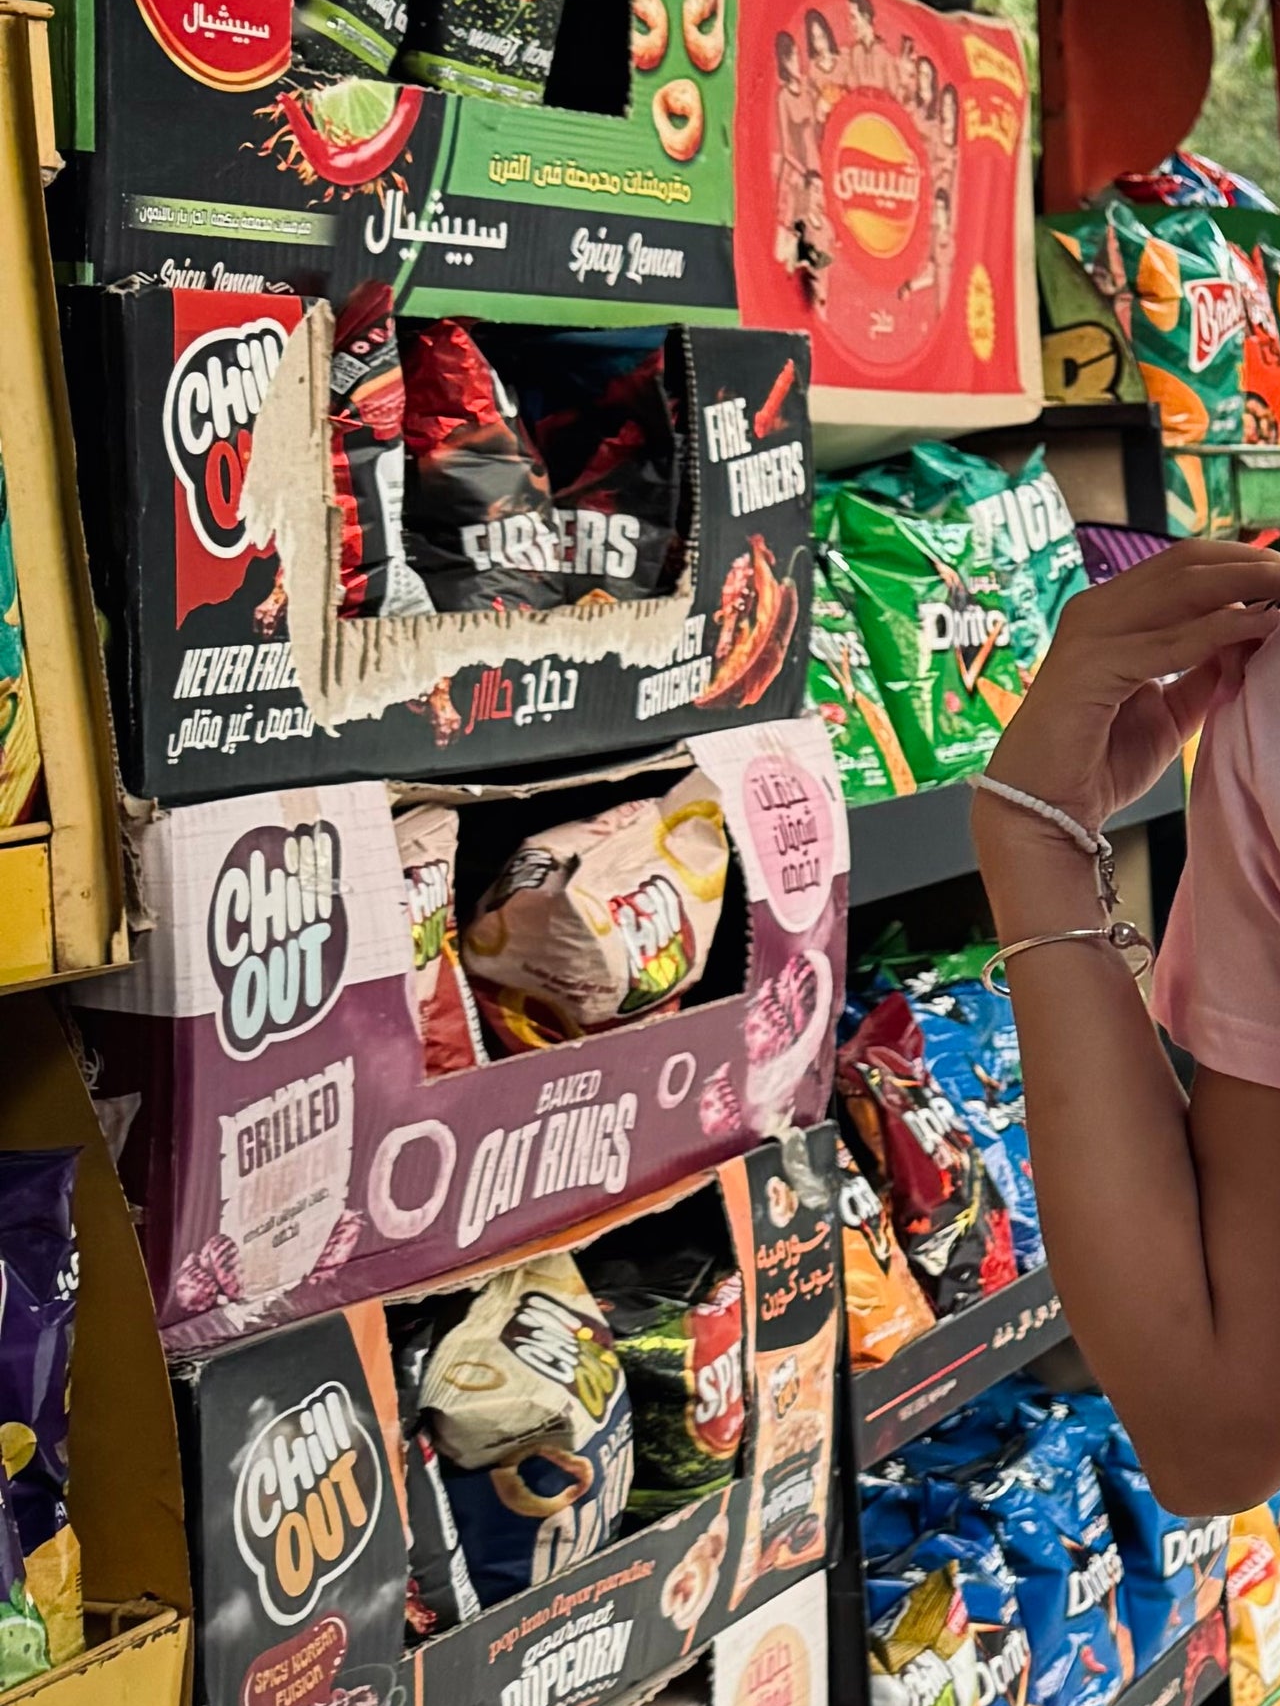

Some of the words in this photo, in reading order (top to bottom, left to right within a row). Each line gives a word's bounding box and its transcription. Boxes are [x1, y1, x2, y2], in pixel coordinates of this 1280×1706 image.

[182, 3, 271, 40] سبيشيال
[488, 152, 531, 186] الفرن
[564, 160, 619, 195] محمصة
[622, 169, 693, 204] مقرمشات
[364, 189, 508, 264] سبيشيال
[570, 226, 624, 285] Spicy
[624, 233, 685, 282] Lemon
[703, 397, 751, 463] FIRE
[726, 441, 805, 517] FINGERS
[173, 645, 251, 700] NEVER
[247, 641, 302, 690] FRIE
[514, 659, 579, 727] دجاج
[222, 703, 254, 755] غير
[230, 922, 331, 1040] OUT
[536, 1069, 602, 1115] BAKED
[237, 1081, 339, 1178] GRILLED
[457, 1127, 543, 1249] OAT
[544, 1092, 637, 1202] RINGS
[274, 1451, 368, 1597] OUT
[254, 1659, 289, 1694] SPICY
